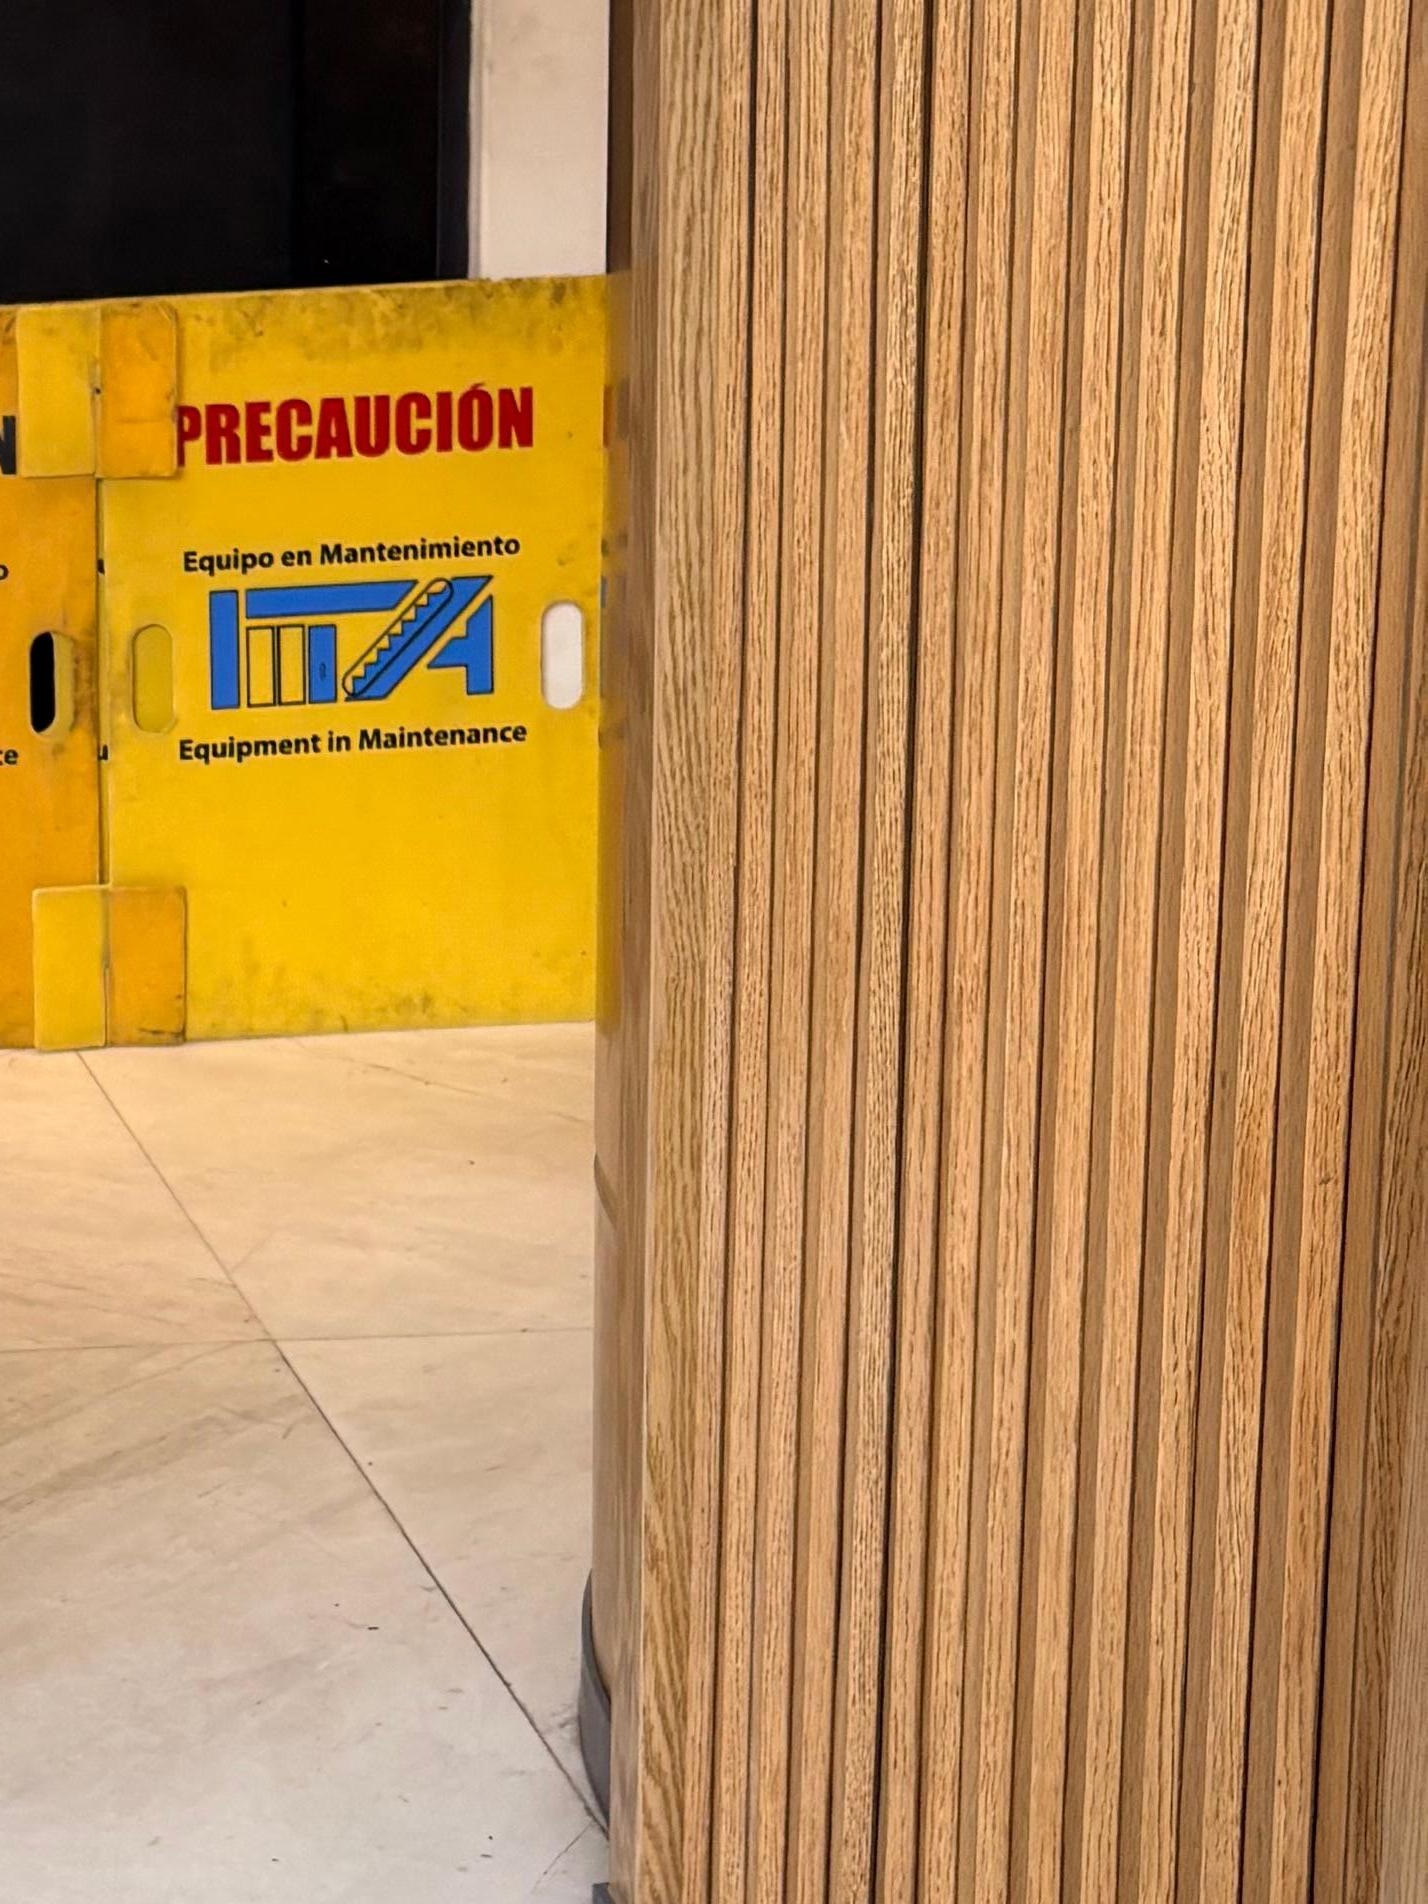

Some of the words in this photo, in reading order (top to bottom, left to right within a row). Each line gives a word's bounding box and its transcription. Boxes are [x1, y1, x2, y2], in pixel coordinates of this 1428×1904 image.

[175, 382, 535, 468] PRECAUCIÓN
[183, 548, 274, 575] Equipo
[280, 550, 312, 567] en
[320, 536, 521, 565] Mantenimiento
[179, 734, 321, 764] Equipment
[327, 730, 351, 752] in
[358, 724, 528, 750] Maintenance
